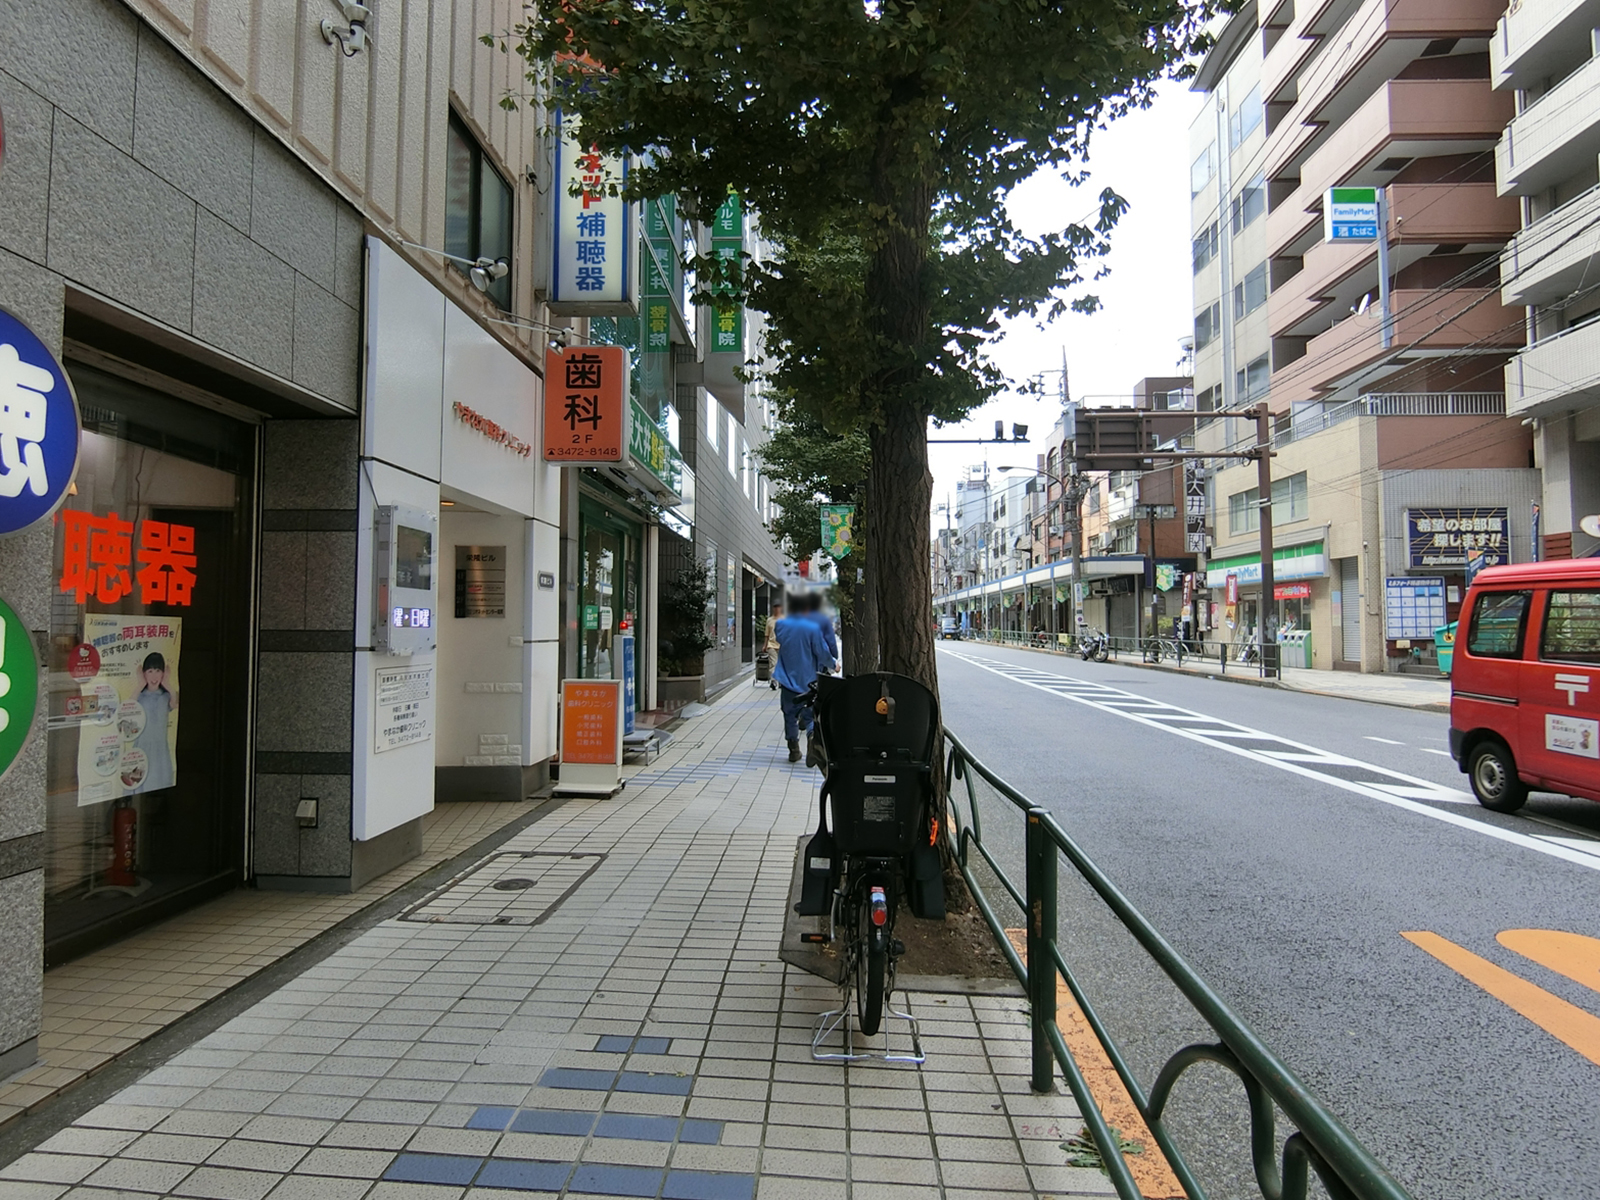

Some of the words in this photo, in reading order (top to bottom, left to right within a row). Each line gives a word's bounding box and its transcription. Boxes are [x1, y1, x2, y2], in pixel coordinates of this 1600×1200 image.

[1333, 208, 1375, 216] FamilyMart
[1337, 226, 1349, 237] 酒
[1352, 227, 1374, 236] たばこ
[575, 212, 606, 291] 補聴器
[563, 352, 603, 431] 歯科
[557, 447, 618, 456] 3472-8148
[1417, 518, 1503, 532] 希望のお部屋
[54, 508, 198, 606] 聴器
[1227, 566, 1258, 581] milyMart
[101, 640, 150, 658] おすすめします
[575, 689, 606, 698] やまなか
[567, 700, 614, 708] 歯科クリニック
